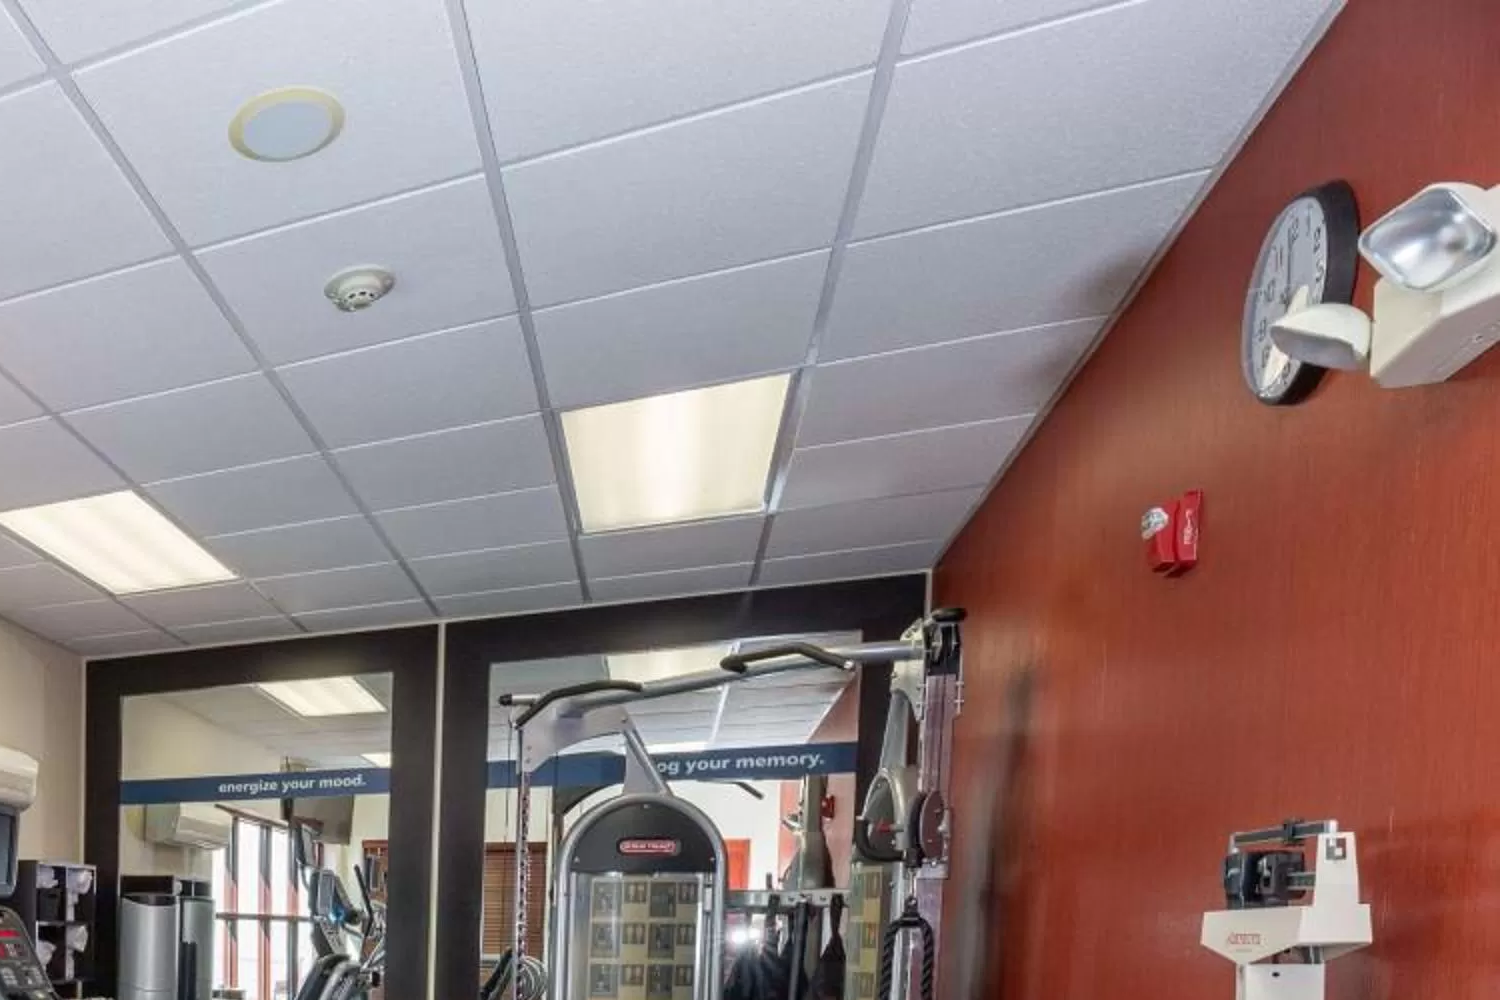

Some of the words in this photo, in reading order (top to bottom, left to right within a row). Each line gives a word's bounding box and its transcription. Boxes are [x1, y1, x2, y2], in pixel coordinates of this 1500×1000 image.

[657, 760, 681, 776] og
[685, 757, 731, 775] your
[735, 752, 826, 770] memory.
[218, 780, 278, 795] energize
[281, 778, 315, 793] your
[319, 773, 367, 788] mood.
